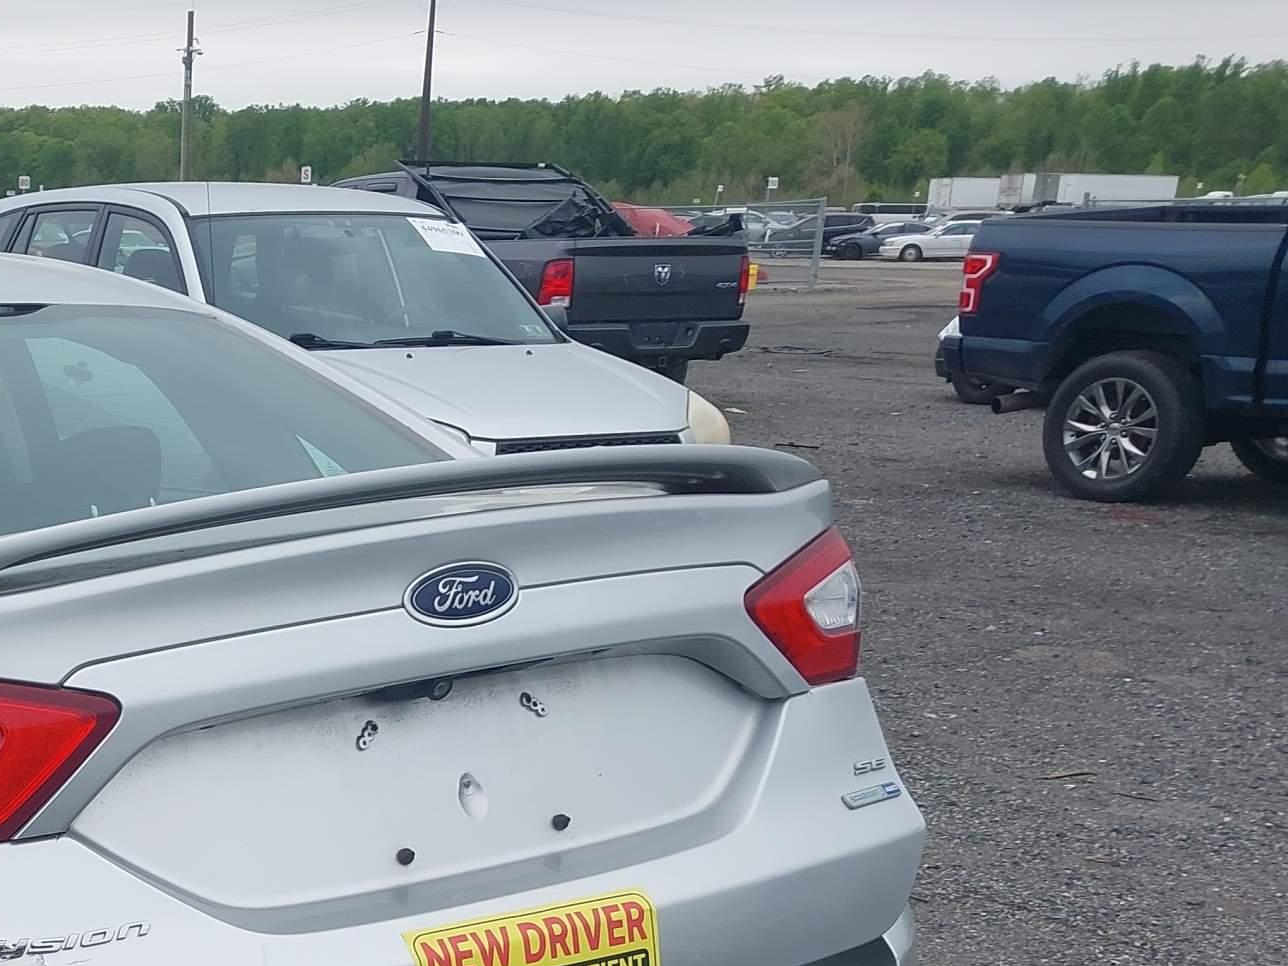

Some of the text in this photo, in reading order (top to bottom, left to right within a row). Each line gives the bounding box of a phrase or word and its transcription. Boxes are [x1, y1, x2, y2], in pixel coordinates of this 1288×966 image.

[433, 575, 497, 612] Ford
[853, 756, 887, 776] SE
[516, 901, 648, 965] DRIVER
